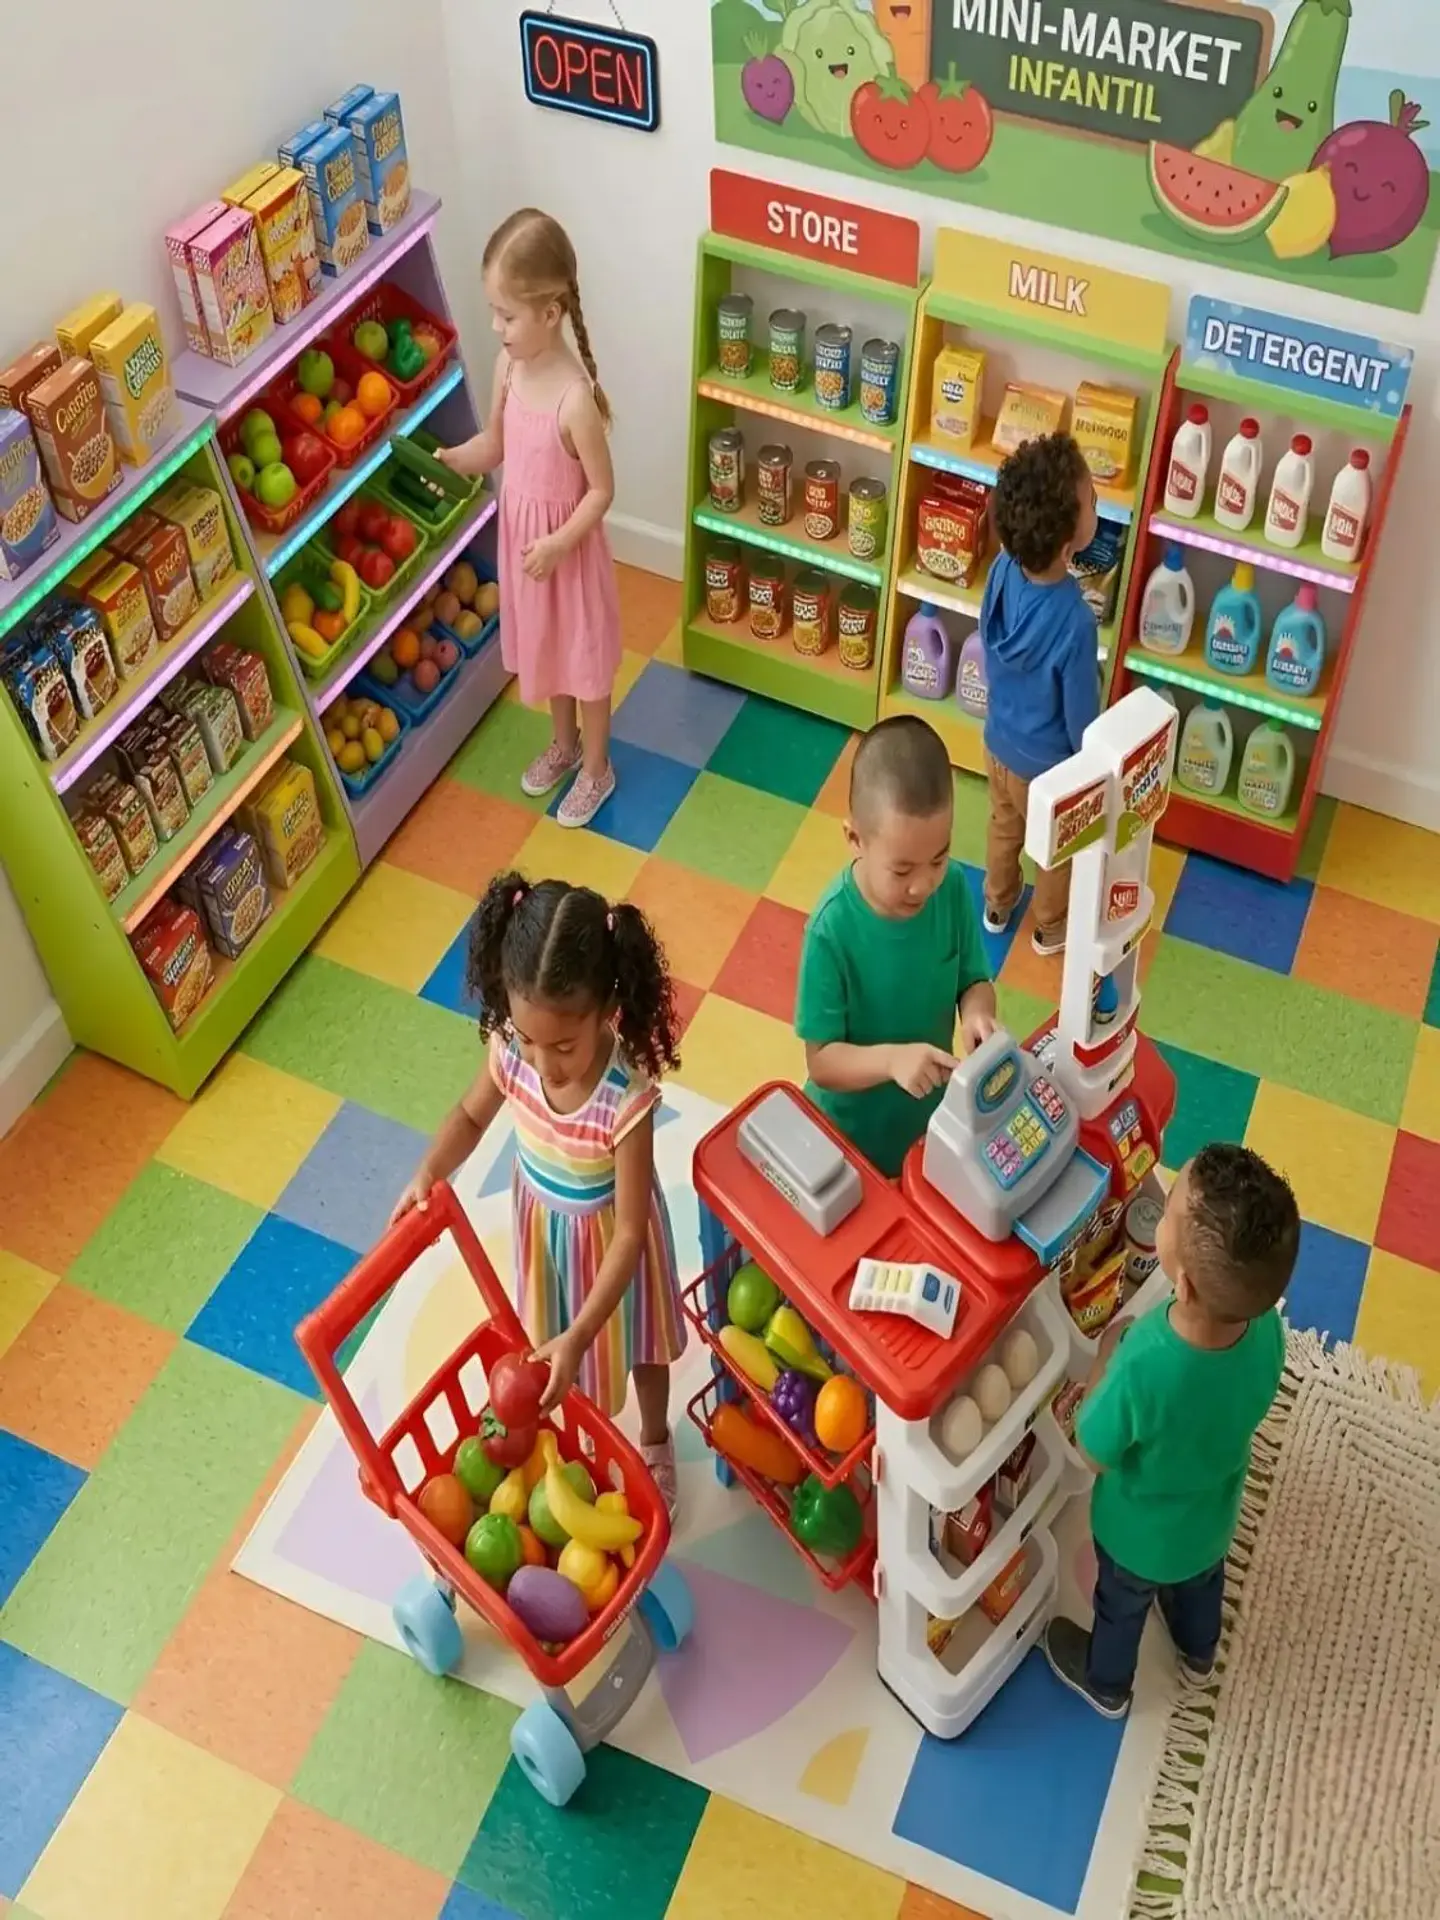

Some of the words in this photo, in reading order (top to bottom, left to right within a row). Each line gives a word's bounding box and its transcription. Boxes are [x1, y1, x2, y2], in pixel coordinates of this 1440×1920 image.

[534, 34, 643, 111] OPEN
[952, 0, 1242, 86] MINI-MARKET
[1008, 54, 1162, 124] INFANTIL
[766, 200, 860, 256] STORE
[1008, 259, 1091, 318] MILK
[1202, 316, 1391, 394] DETERGENT
